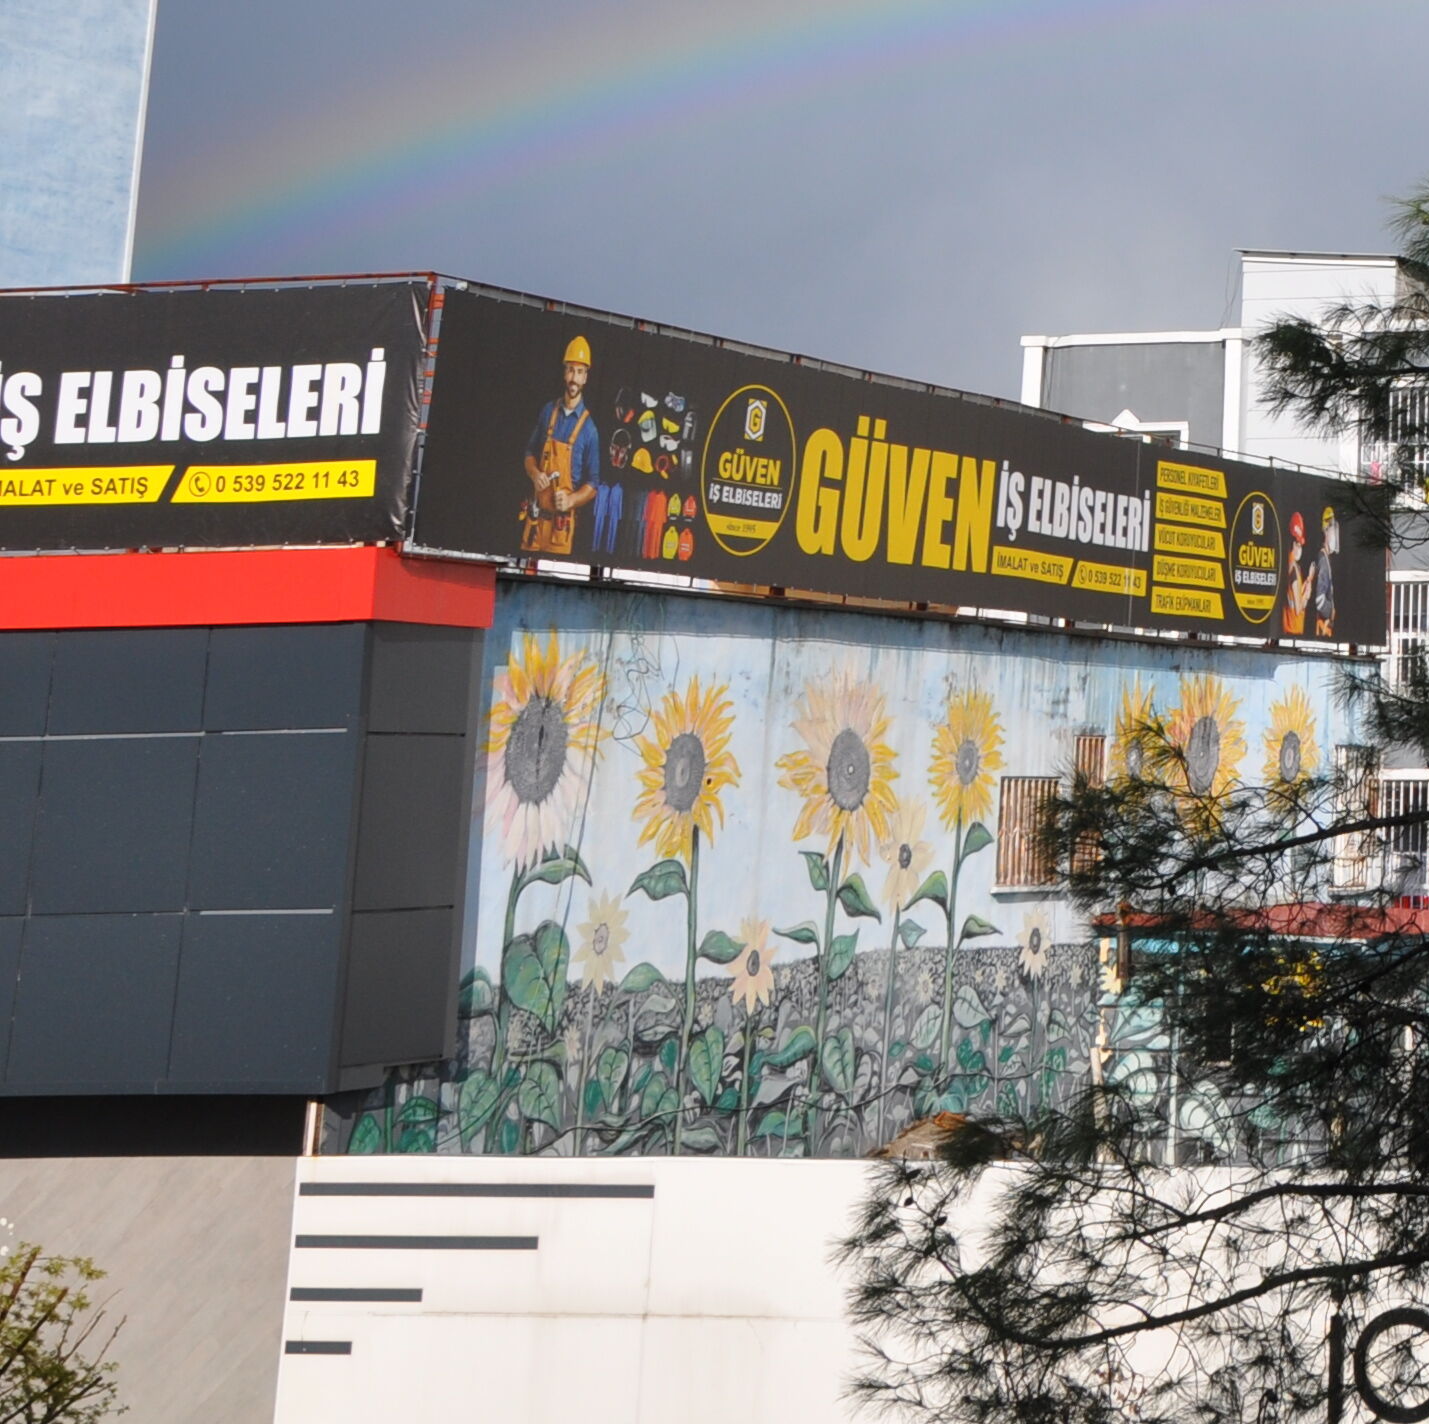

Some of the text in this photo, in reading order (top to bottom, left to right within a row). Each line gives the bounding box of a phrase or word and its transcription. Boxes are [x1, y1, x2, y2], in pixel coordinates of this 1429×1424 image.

[0, 348, 386, 461] Ş ELBİSELERİ
[215, 469, 359, 493] 0 539 522 11 43
[718, 448, 781, 486] GÜVEN
[0, 476, 149, 499] ALAT ve SATIŞ
[708, 483, 783, 510] İŞ ELBİSELERİ
[796, 415, 1150, 573] GÜVEN İŞ ELBİSELERİ
[996, 551, 1064, 582] İMALAT ve SATIŞ
[1239, 541, 1275, 569] GÜVEN
[1087, 571, 1093, 583] 0
[1094, 572, 1107, 585] 539
[1109, 573, 1121, 587] 522
